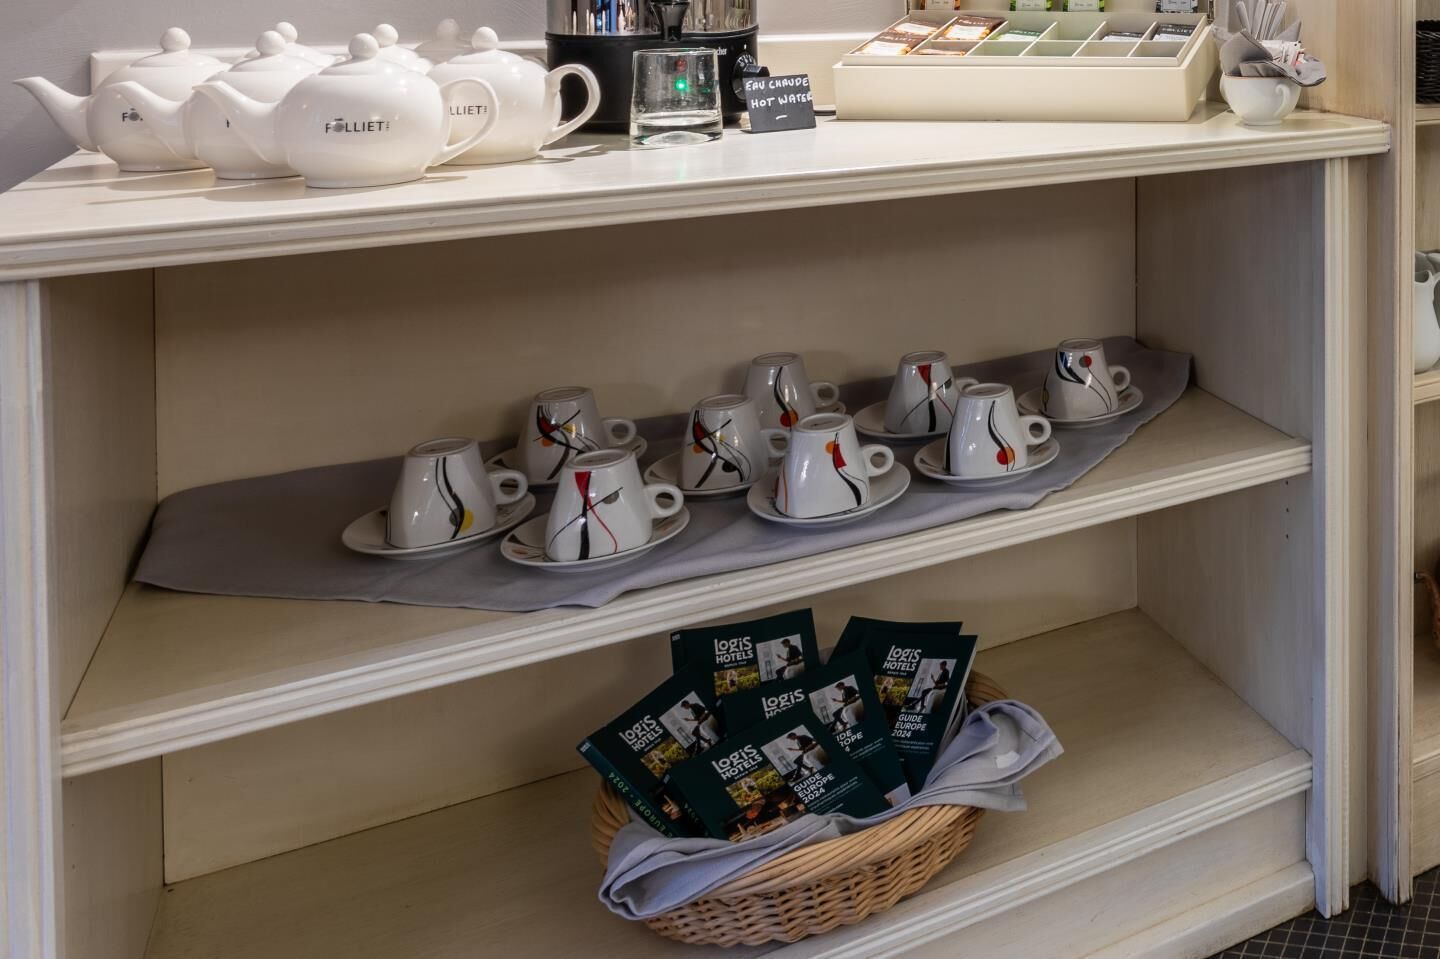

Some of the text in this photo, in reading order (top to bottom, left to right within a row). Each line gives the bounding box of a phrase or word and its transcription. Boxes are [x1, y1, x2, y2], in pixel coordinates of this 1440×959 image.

[745, 77, 809, 91] EAU CHAUDE
[751, 97, 775, 109] HOT
[325, 121, 385, 134] FOLLIET
[715, 650, 754, 665] HOTELS
[882, 661, 918, 672] HOTELS
[898, 714, 923, 722] GUIDE
[894, 721, 927, 731] EUROPE
[631, 726, 664, 752] HOTELS
[891, 729, 912, 739] 2024
[721, 754, 764, 781] HOTELS
[608, 771, 630, 793] 2024
[793, 772, 823, 792] GUIDE
[798, 773, 836, 799] EUROPE
[802, 787, 826, 804] 2024
